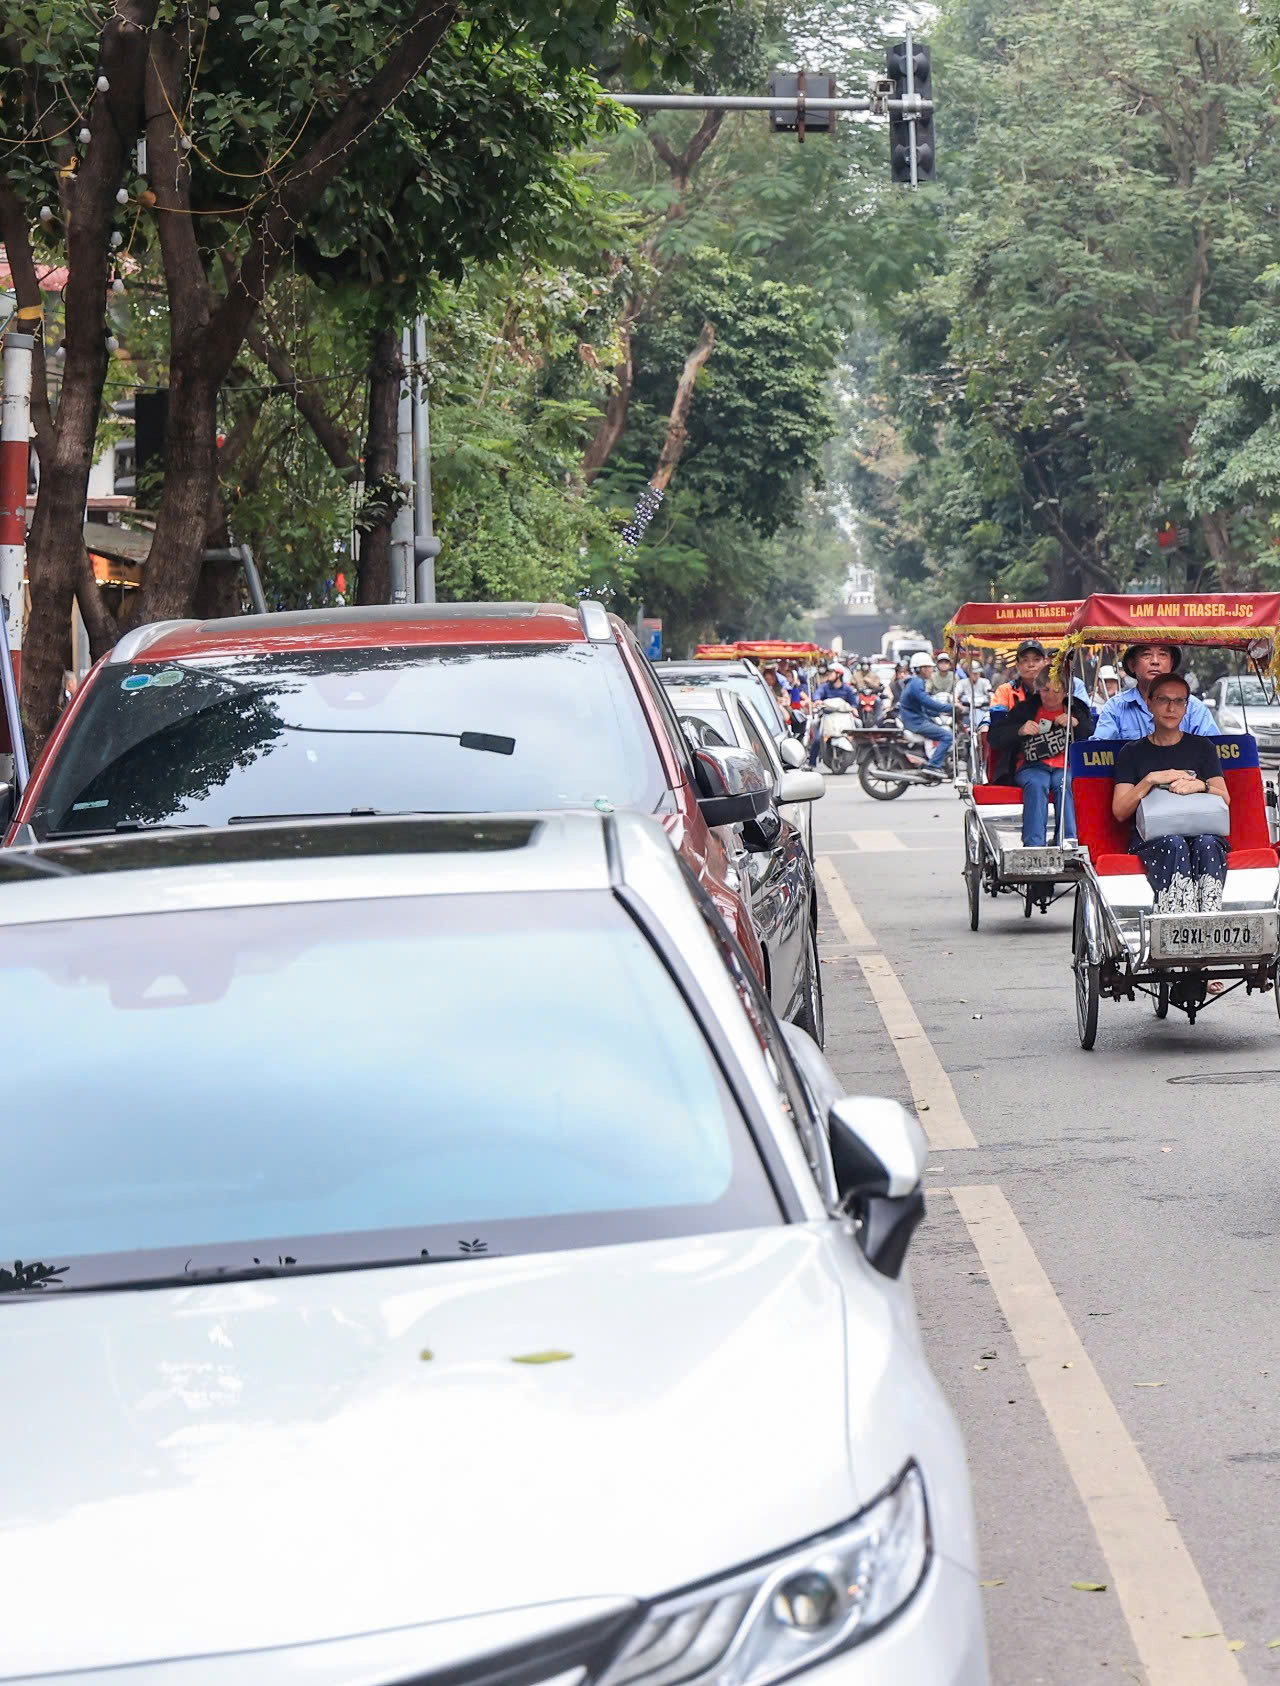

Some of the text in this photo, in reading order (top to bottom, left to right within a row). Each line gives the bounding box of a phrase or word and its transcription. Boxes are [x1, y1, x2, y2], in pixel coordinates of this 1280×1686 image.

[996, 608, 1014, 620] LAM
[1016, 608, 1034, 619] ANH
[1129, 604, 1154, 618] LAM
[1157, 603, 1180, 617] ANH
[1083, 751, 1115, 766] LAM
[1172, 926, 1252, 944] 29XL-0070
